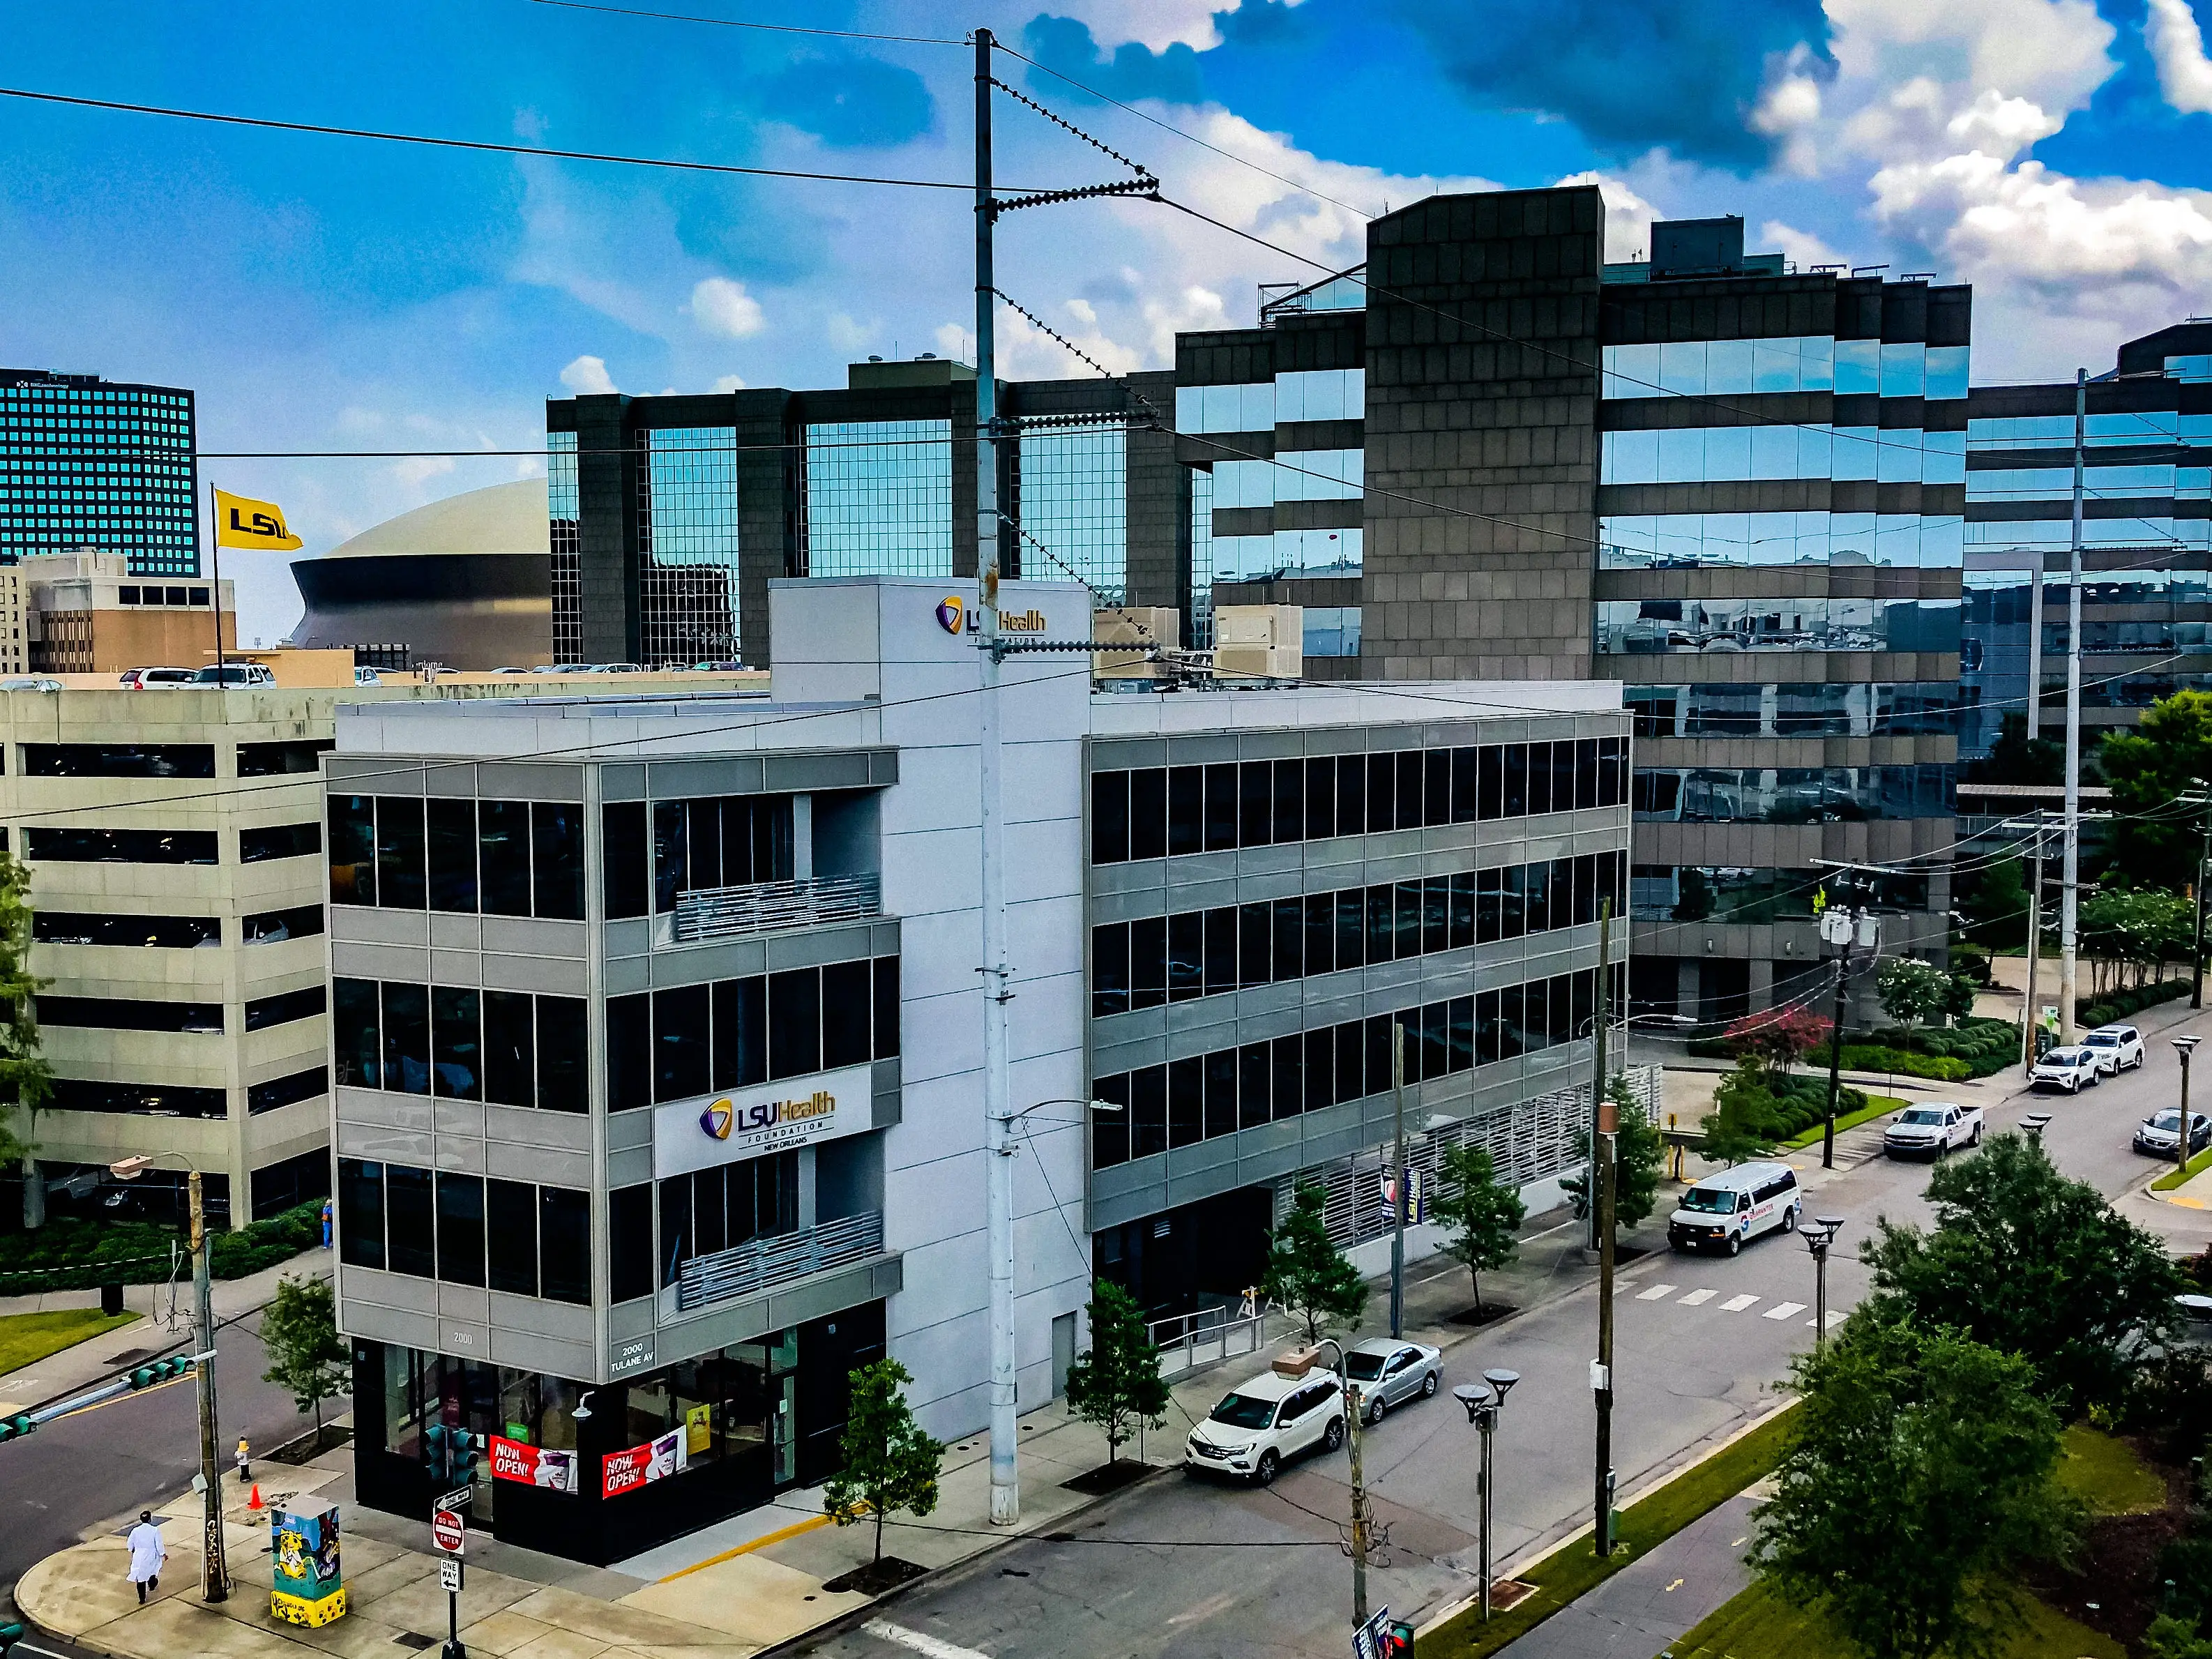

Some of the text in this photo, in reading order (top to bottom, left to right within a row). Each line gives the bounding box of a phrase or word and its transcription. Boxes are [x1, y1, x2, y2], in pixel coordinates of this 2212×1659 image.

[230, 508, 287, 539] LSU
[748, 1121, 823, 1143] FOUNDATION
[764, 1136, 808, 1151] NEW ORLEANS
[454, 1332, 473, 1345] 2000
[622, 1342, 643, 1356] 2000
[611, 1351, 654, 1372] TULANE AV
[494, 1443, 520, 1460] NOW
[496, 1457, 529, 1477] OPEN!
[606, 1454, 633, 1476] NOW
[607, 1467, 640, 1492] OPEN!
[446, 1490, 468, 1506] ONE WAY
[438, 1517, 459, 1528] DO NOT
[440, 1534, 459, 1545] ENTER
[442, 1561, 457, 1572] ONE
[441, 1570, 457, 1580] WAY
